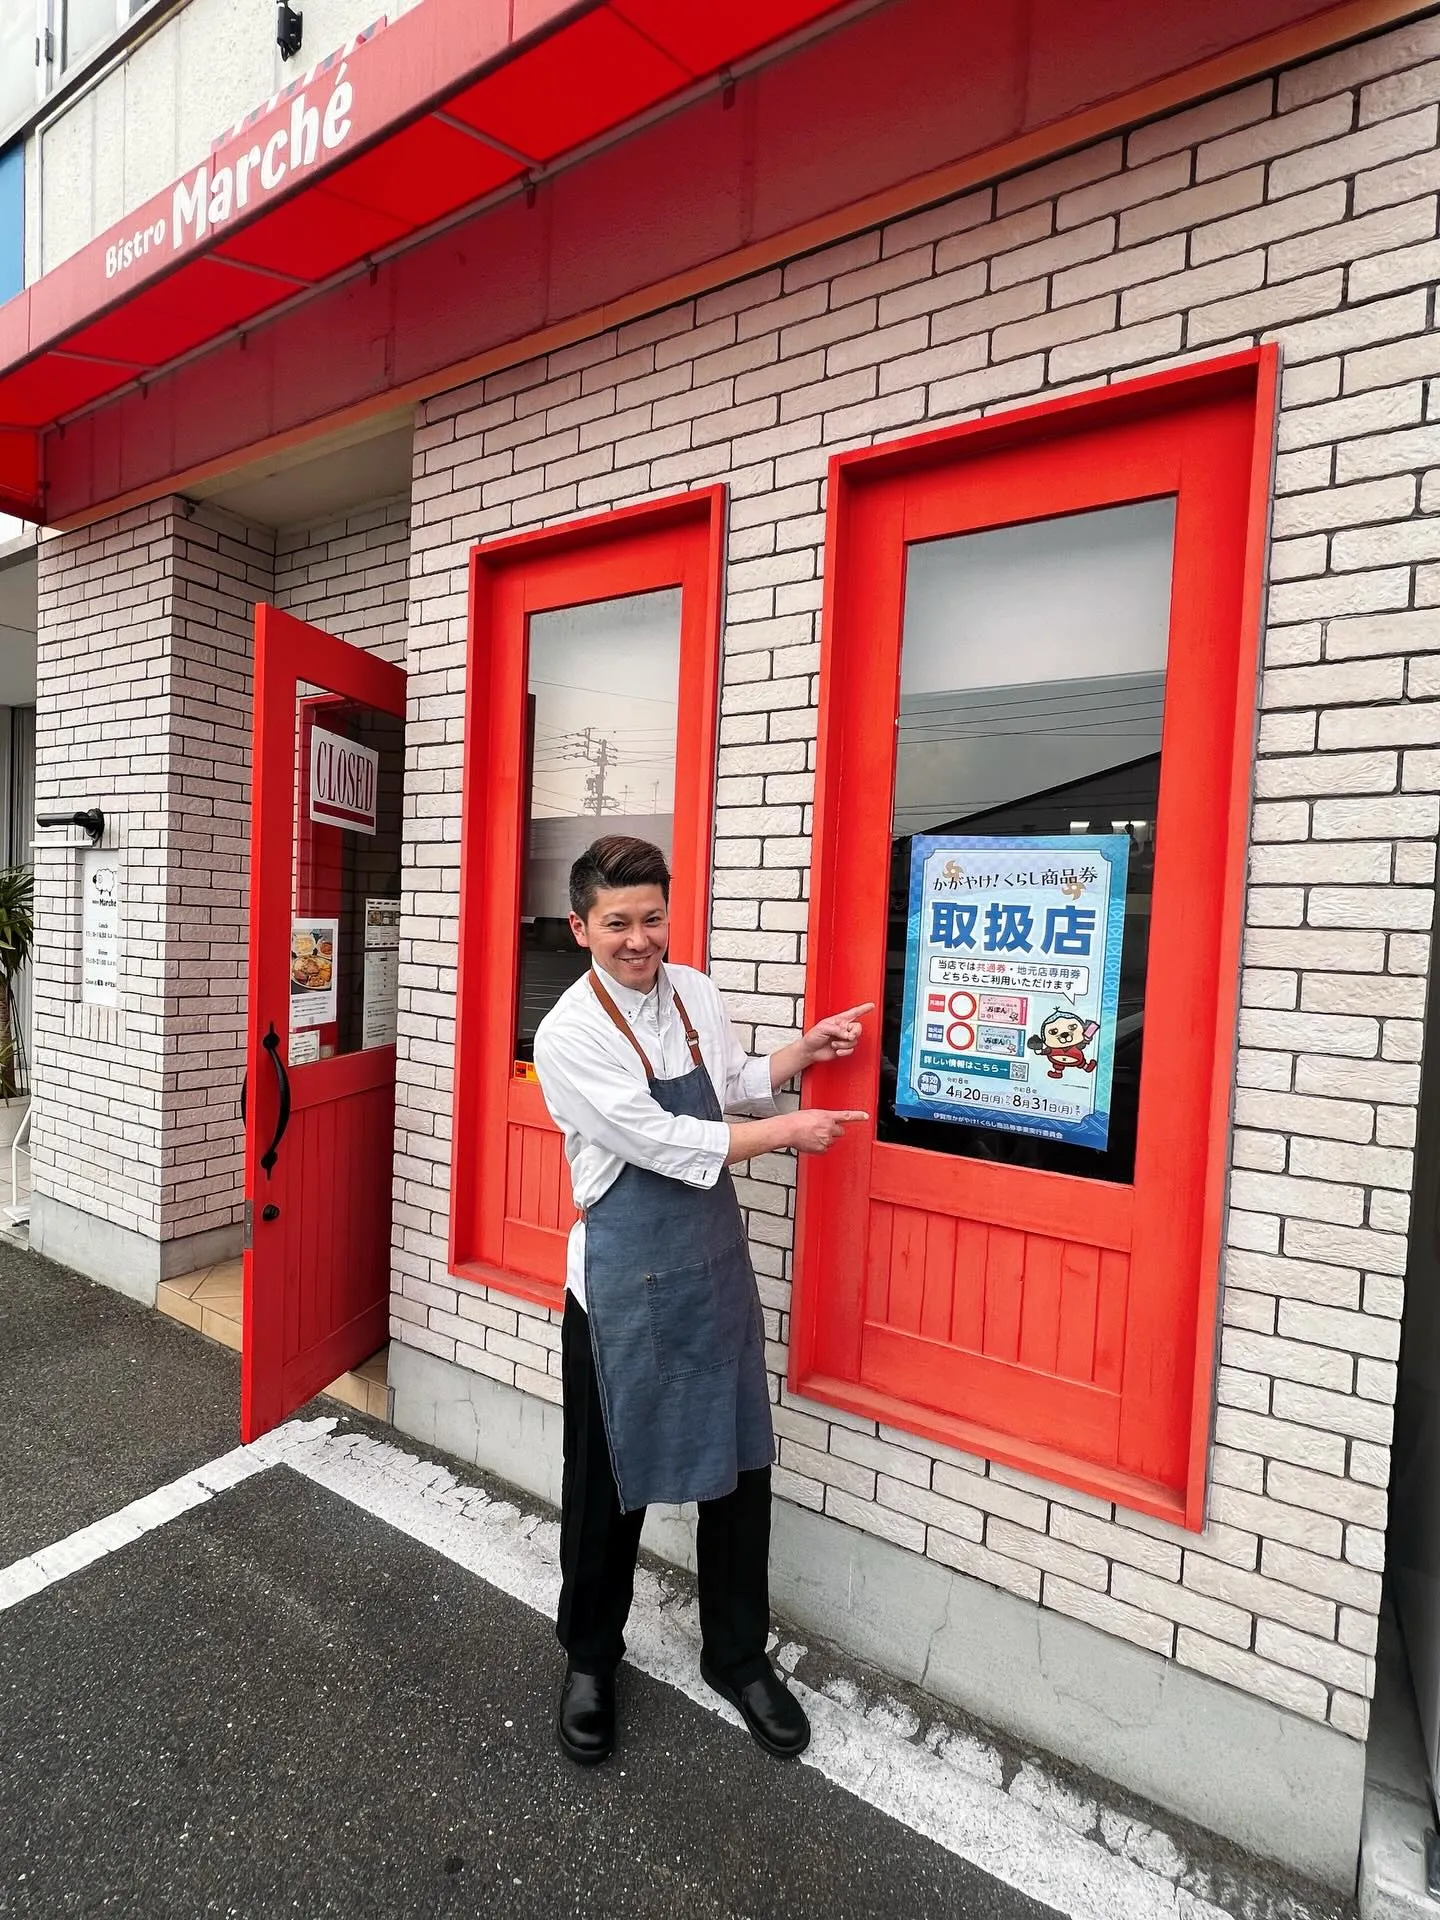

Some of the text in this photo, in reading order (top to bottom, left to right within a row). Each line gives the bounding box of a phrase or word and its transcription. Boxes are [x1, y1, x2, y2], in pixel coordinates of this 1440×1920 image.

[105, 61, 353, 279] Bistro Marché
[317, 741, 373, 811] CLOSED
[929, 901, 1096, 956] 取扱店
[938, 960, 1081, 979] 当店では共通券・地元店専用券
[942, 971, 1074, 990] どちらもご利用いただけます
[923, 1055, 1001, 1073] 詳しい情報はこちら
